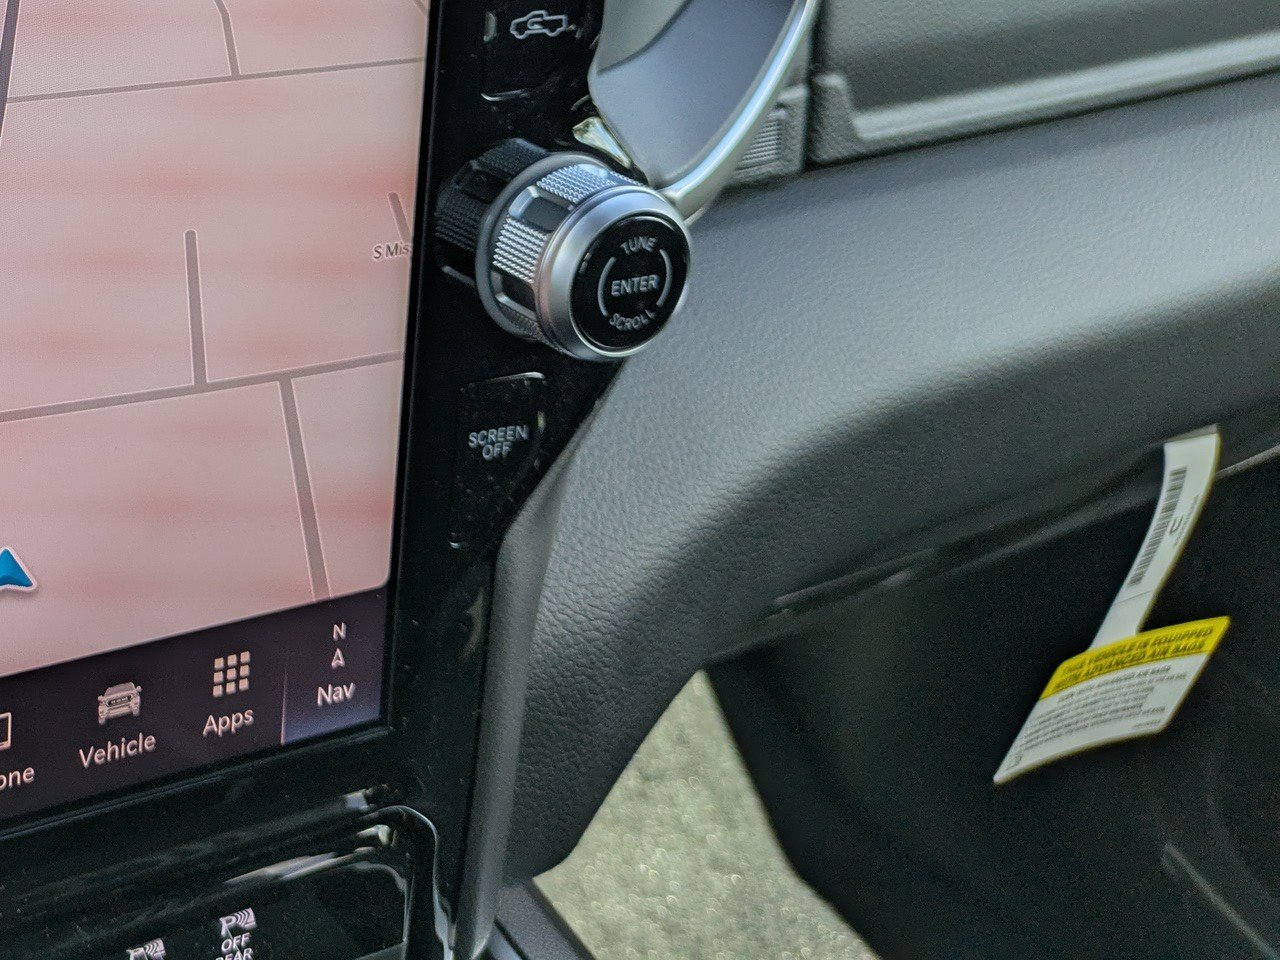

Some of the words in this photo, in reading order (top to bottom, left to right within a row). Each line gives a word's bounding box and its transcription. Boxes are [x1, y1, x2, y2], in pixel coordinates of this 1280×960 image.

[373, 245, 383, 260] S
[620, 237, 657, 255] TUNE
[611, 274, 660, 297] ENTER
[608, 309, 657, 332] SCROLL
[468, 424, 529, 448] SCREEN
[482, 441, 512, 462] OFF
[332, 621, 348, 641] N
[317, 681, 356, 707] Nav
[202, 707, 255, 739] Apps
[79, 732, 157, 769] Vehicle
[221, 932, 251, 952] OFF
[215, 947, 254, 960] EAR
